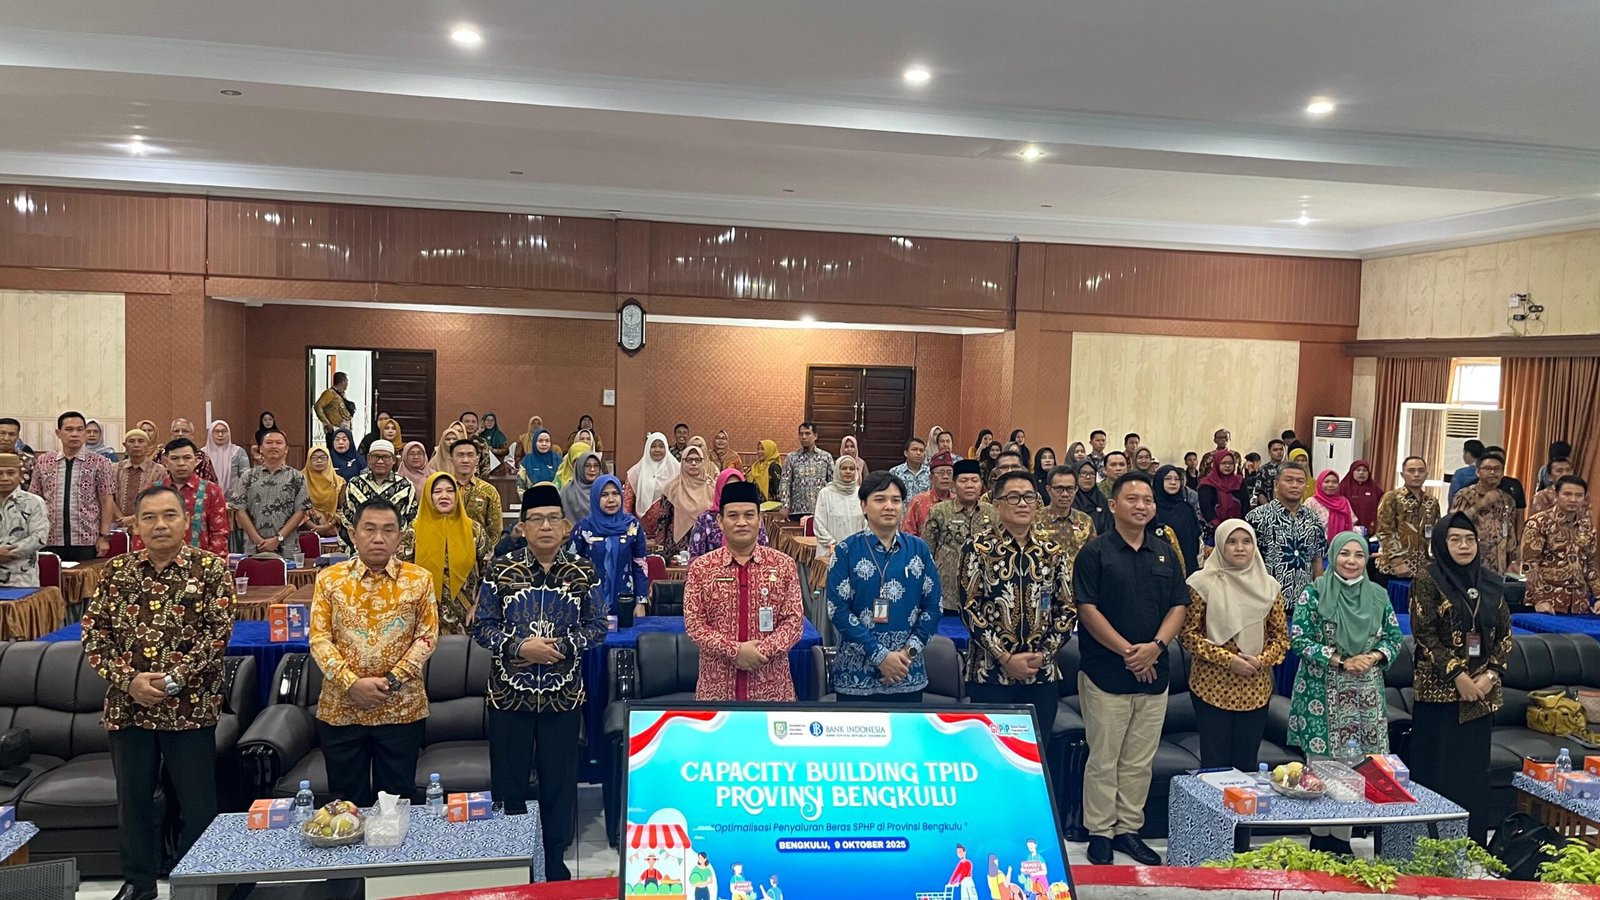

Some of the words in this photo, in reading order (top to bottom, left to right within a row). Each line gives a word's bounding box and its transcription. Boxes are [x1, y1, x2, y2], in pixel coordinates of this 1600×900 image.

[826, 725, 845, 733] BANK
[847, 725, 886, 734] INDONESIA
[680, 761, 797, 782] CAPACITY
[806, 761, 920, 784] BUILDING
[923, 761, 979, 782] TPID
[716, 785, 824, 821] PROVINSI
[831, 785, 958, 809] BENGKULU
[773, 823, 824, 834] Penyaluran
[826, 823, 850, 831] Beras
[853, 823, 875, 831] SPHP
[877, 822, 885, 831] di
[887, 822, 920, 831] Provinsi
[923, 822, 962, 833] Bengkulu
[779, 841, 831, 850] BENGKULU,
[834, 841, 840, 849] 9
[842, 841, 884, 849] OKTOBER
[886, 840, 906, 848] 2025
